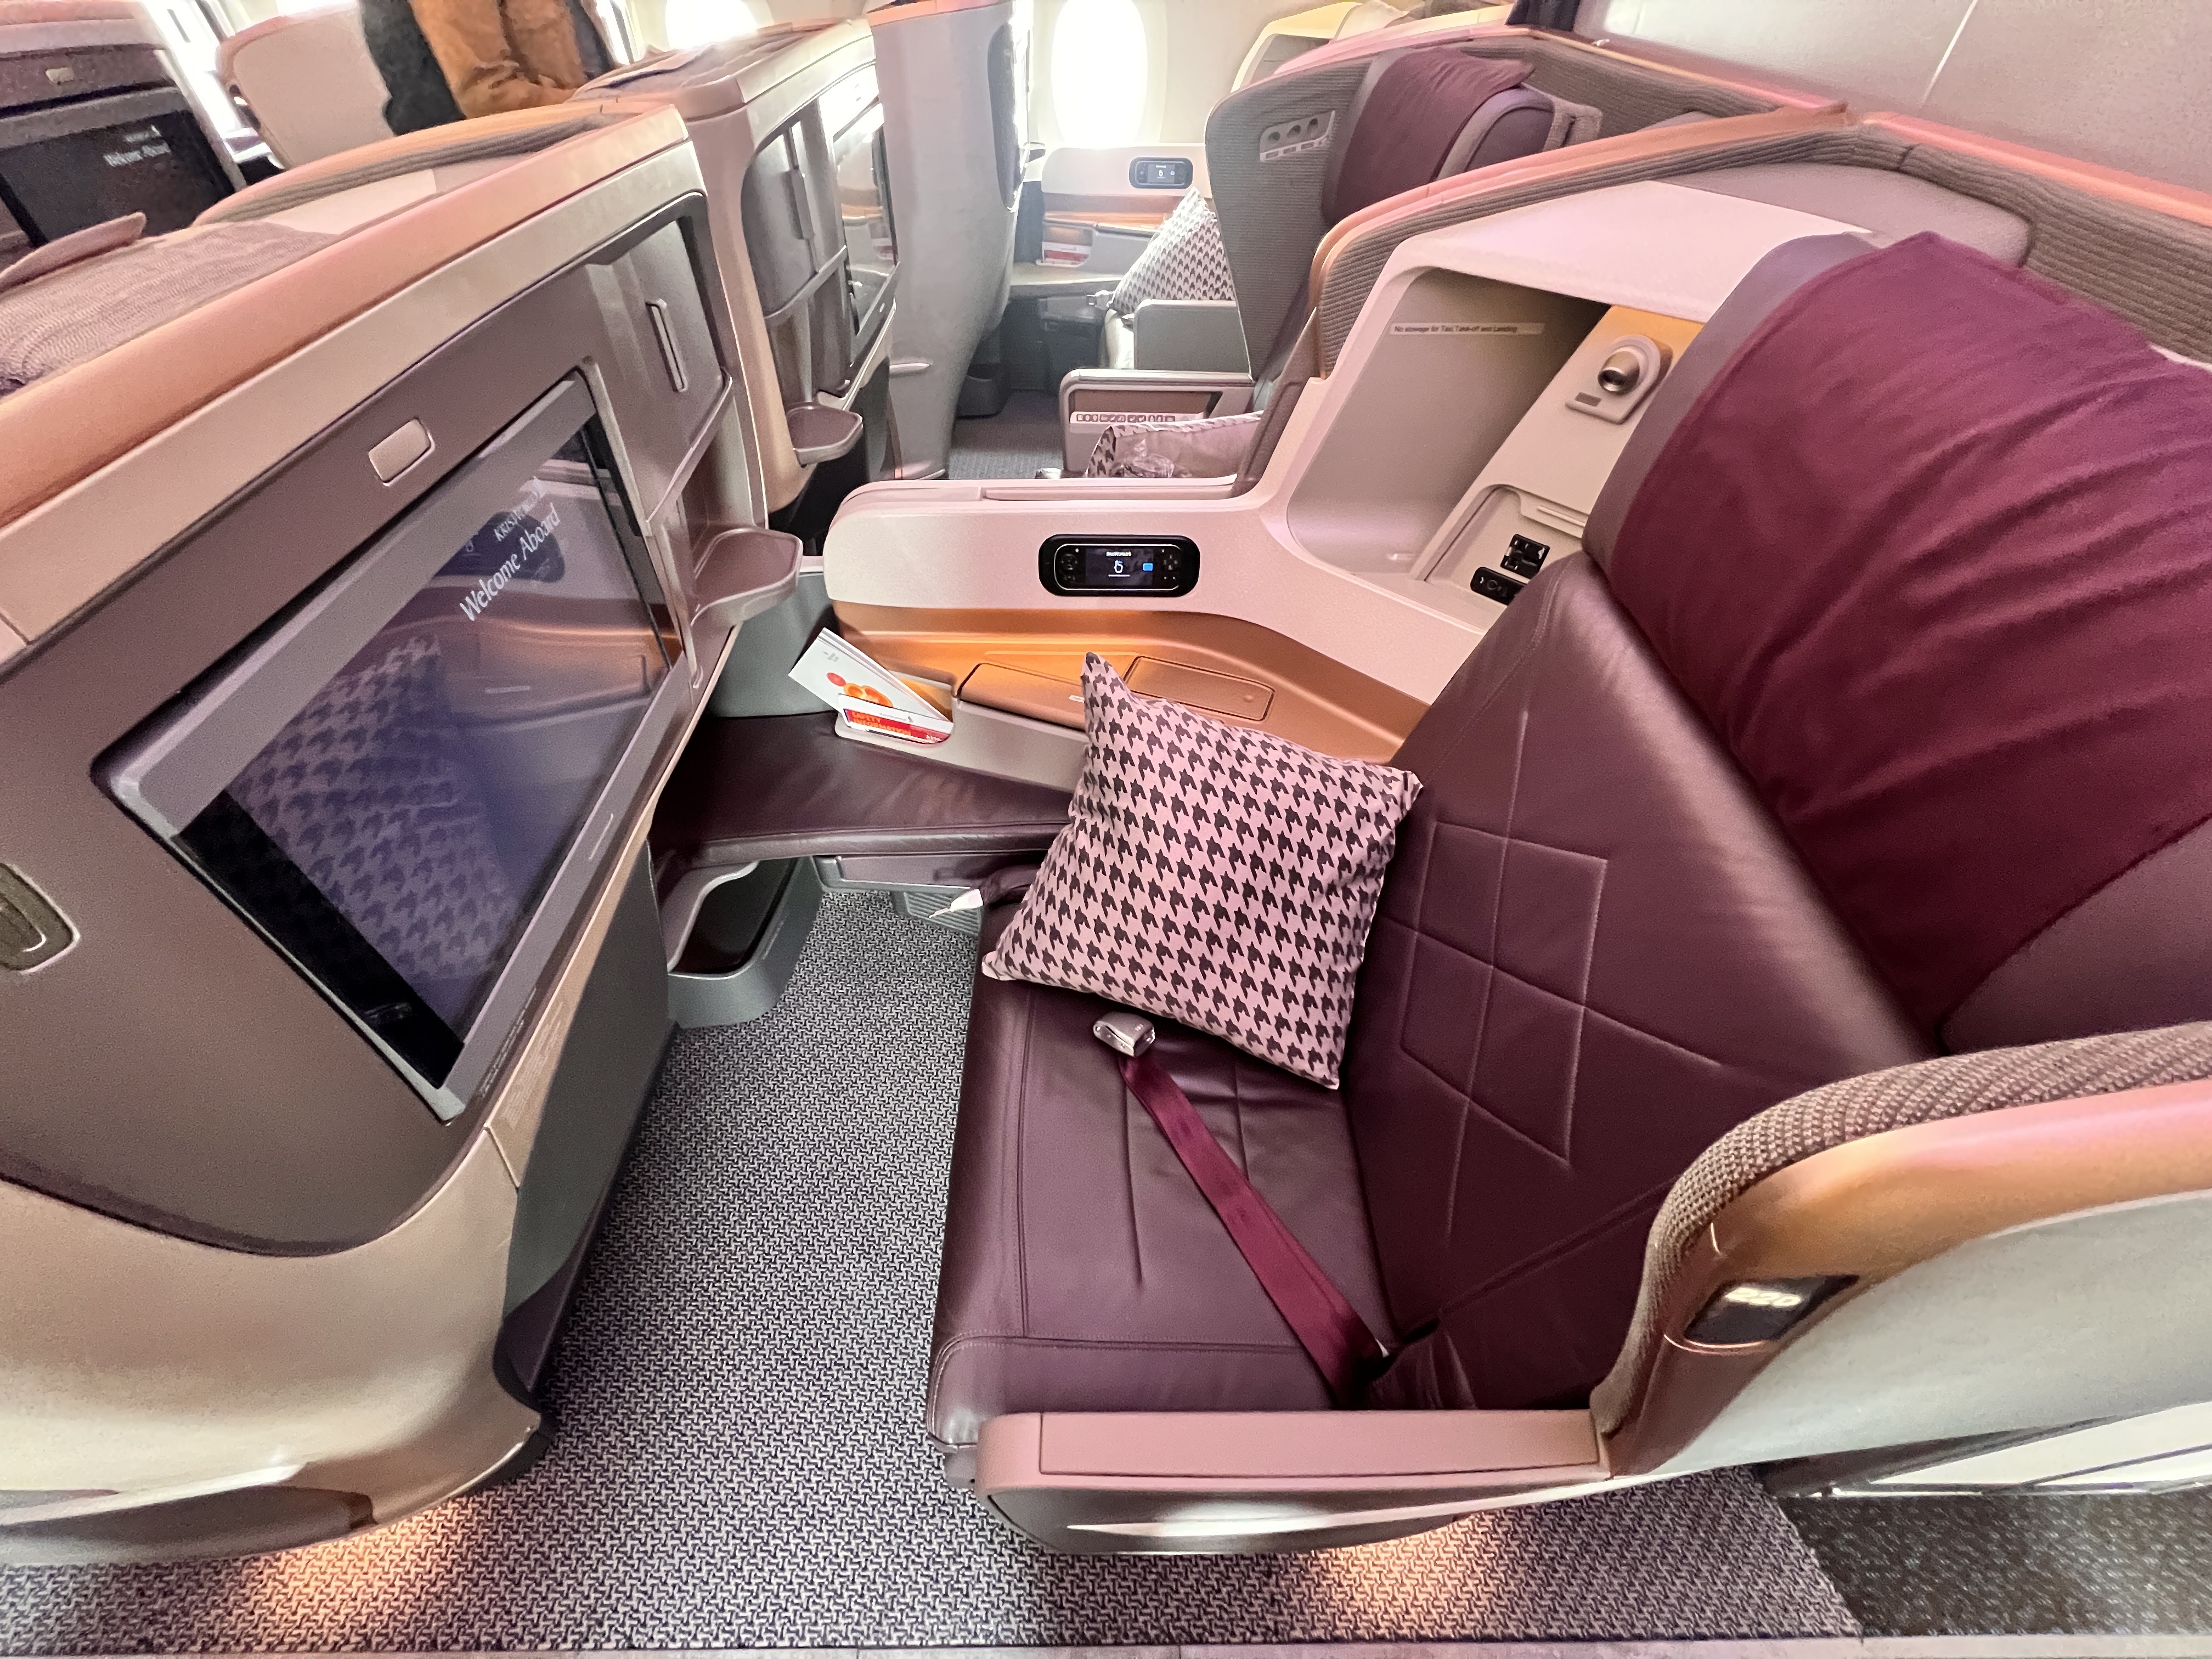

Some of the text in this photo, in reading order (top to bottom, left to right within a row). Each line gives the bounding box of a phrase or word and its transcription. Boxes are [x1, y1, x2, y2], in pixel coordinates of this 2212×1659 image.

[460, 502, 561, 621] Welcome Aboard
[851, 711, 881, 724] SAFETY
[853, 717, 911, 736] INFORMATION
